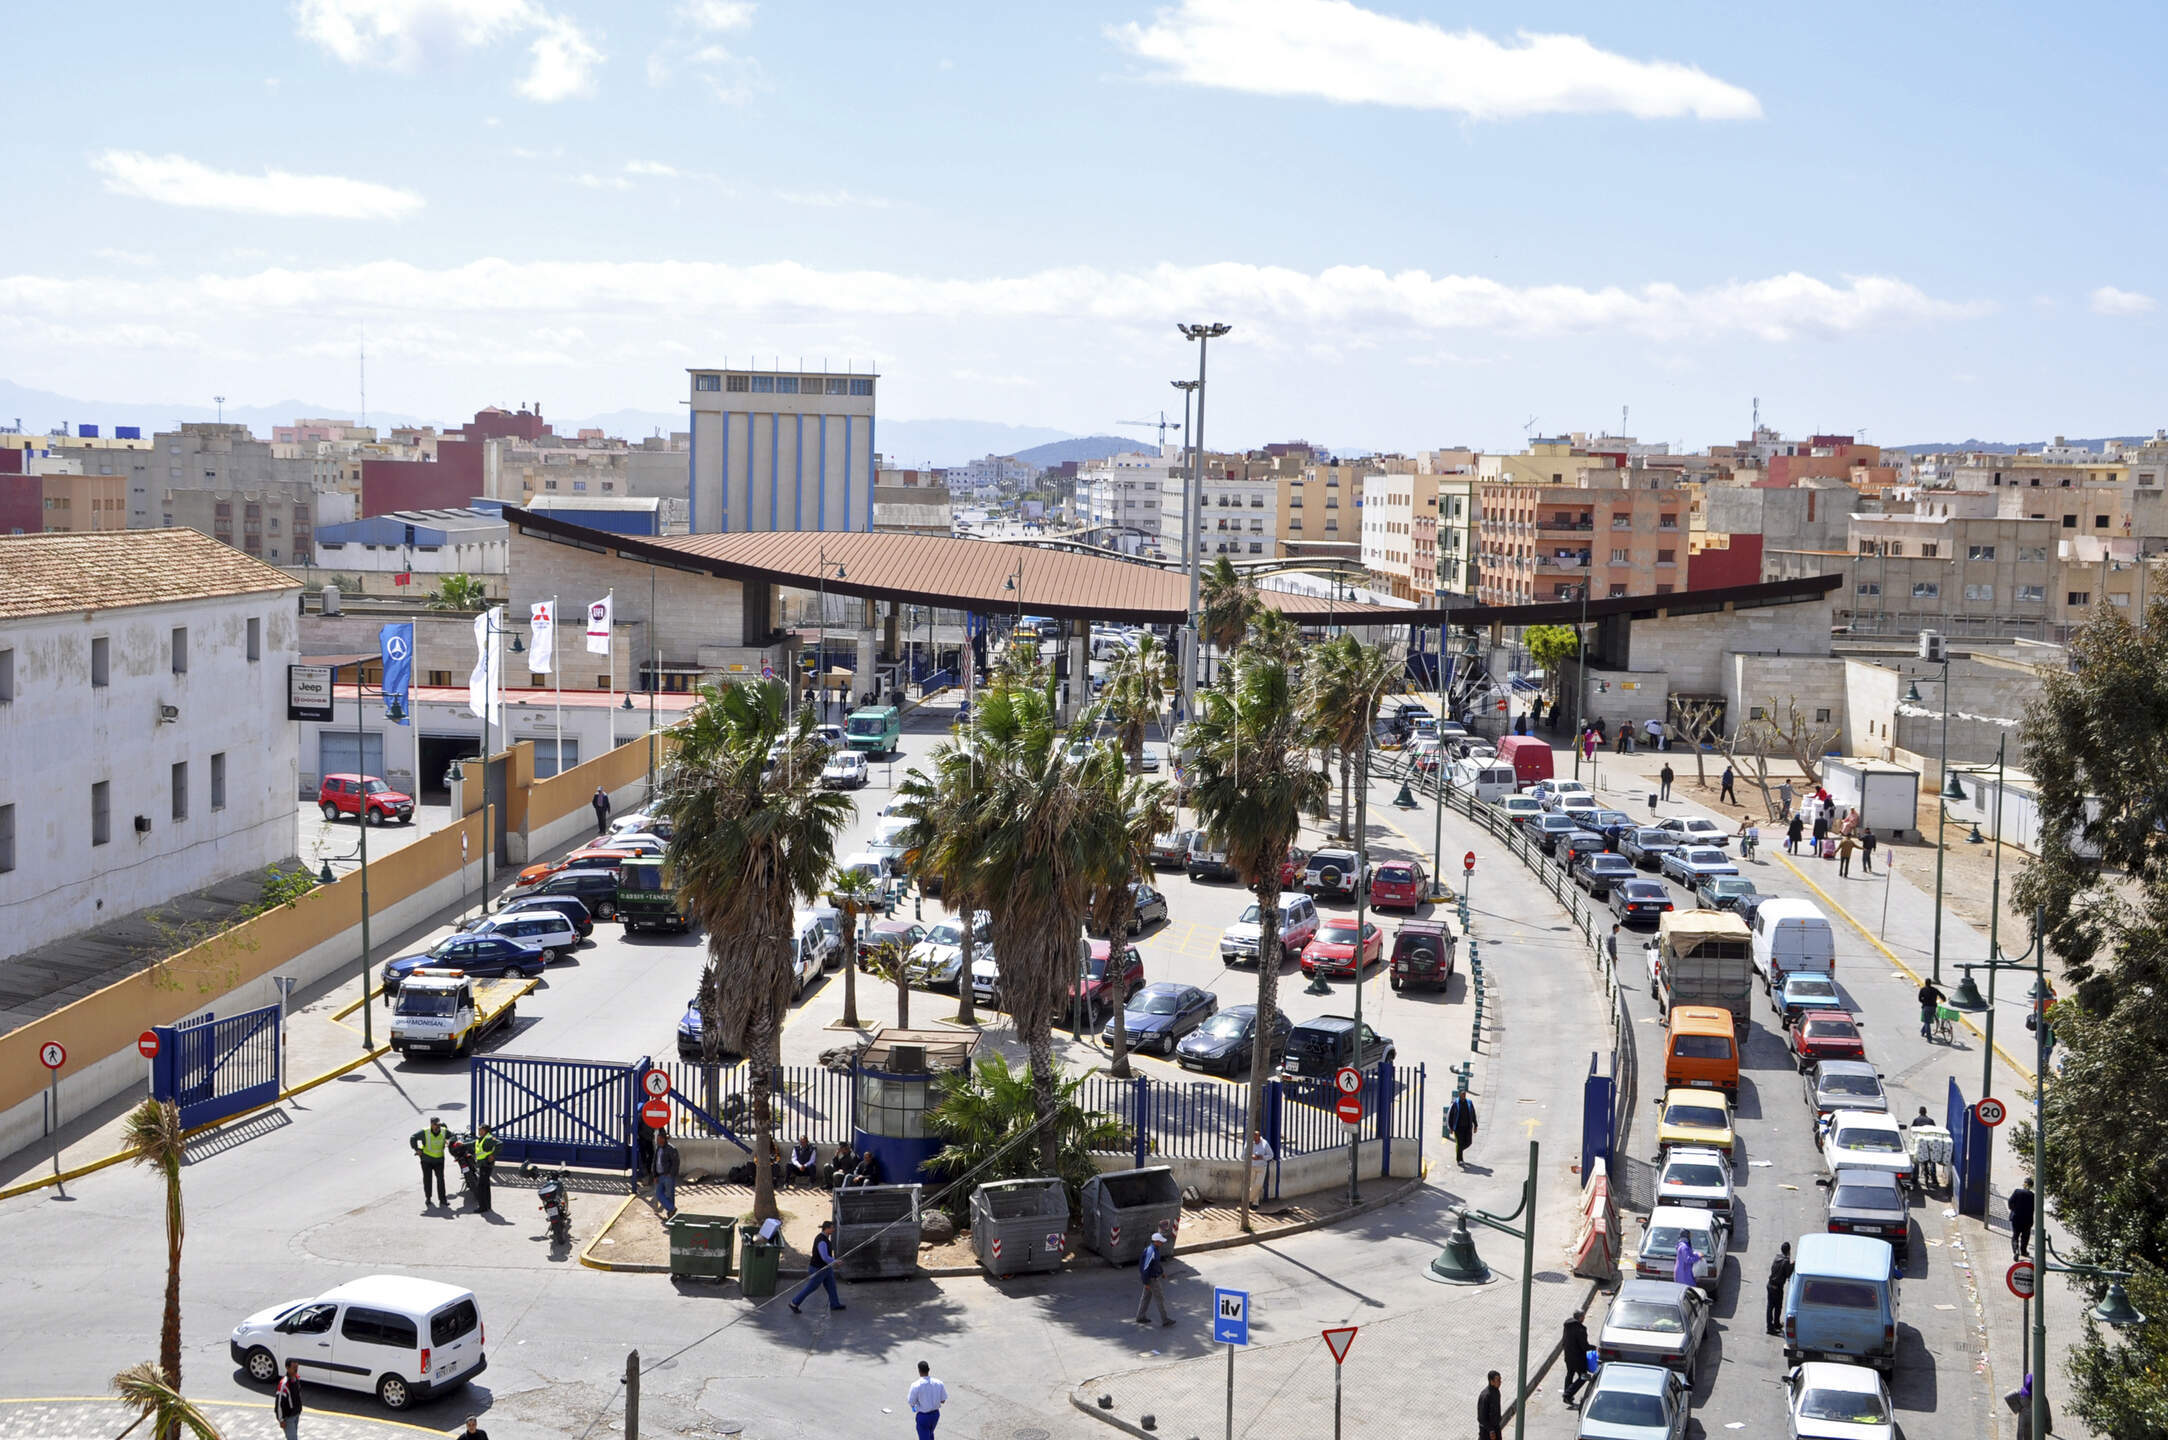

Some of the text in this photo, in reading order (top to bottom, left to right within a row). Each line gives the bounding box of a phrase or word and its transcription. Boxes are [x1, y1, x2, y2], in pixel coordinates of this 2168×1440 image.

[298, 682, 322, 693] Jeep
[1981, 1106, 2001, 1119] 20
[1221, 1299, 1242, 1317] itv
